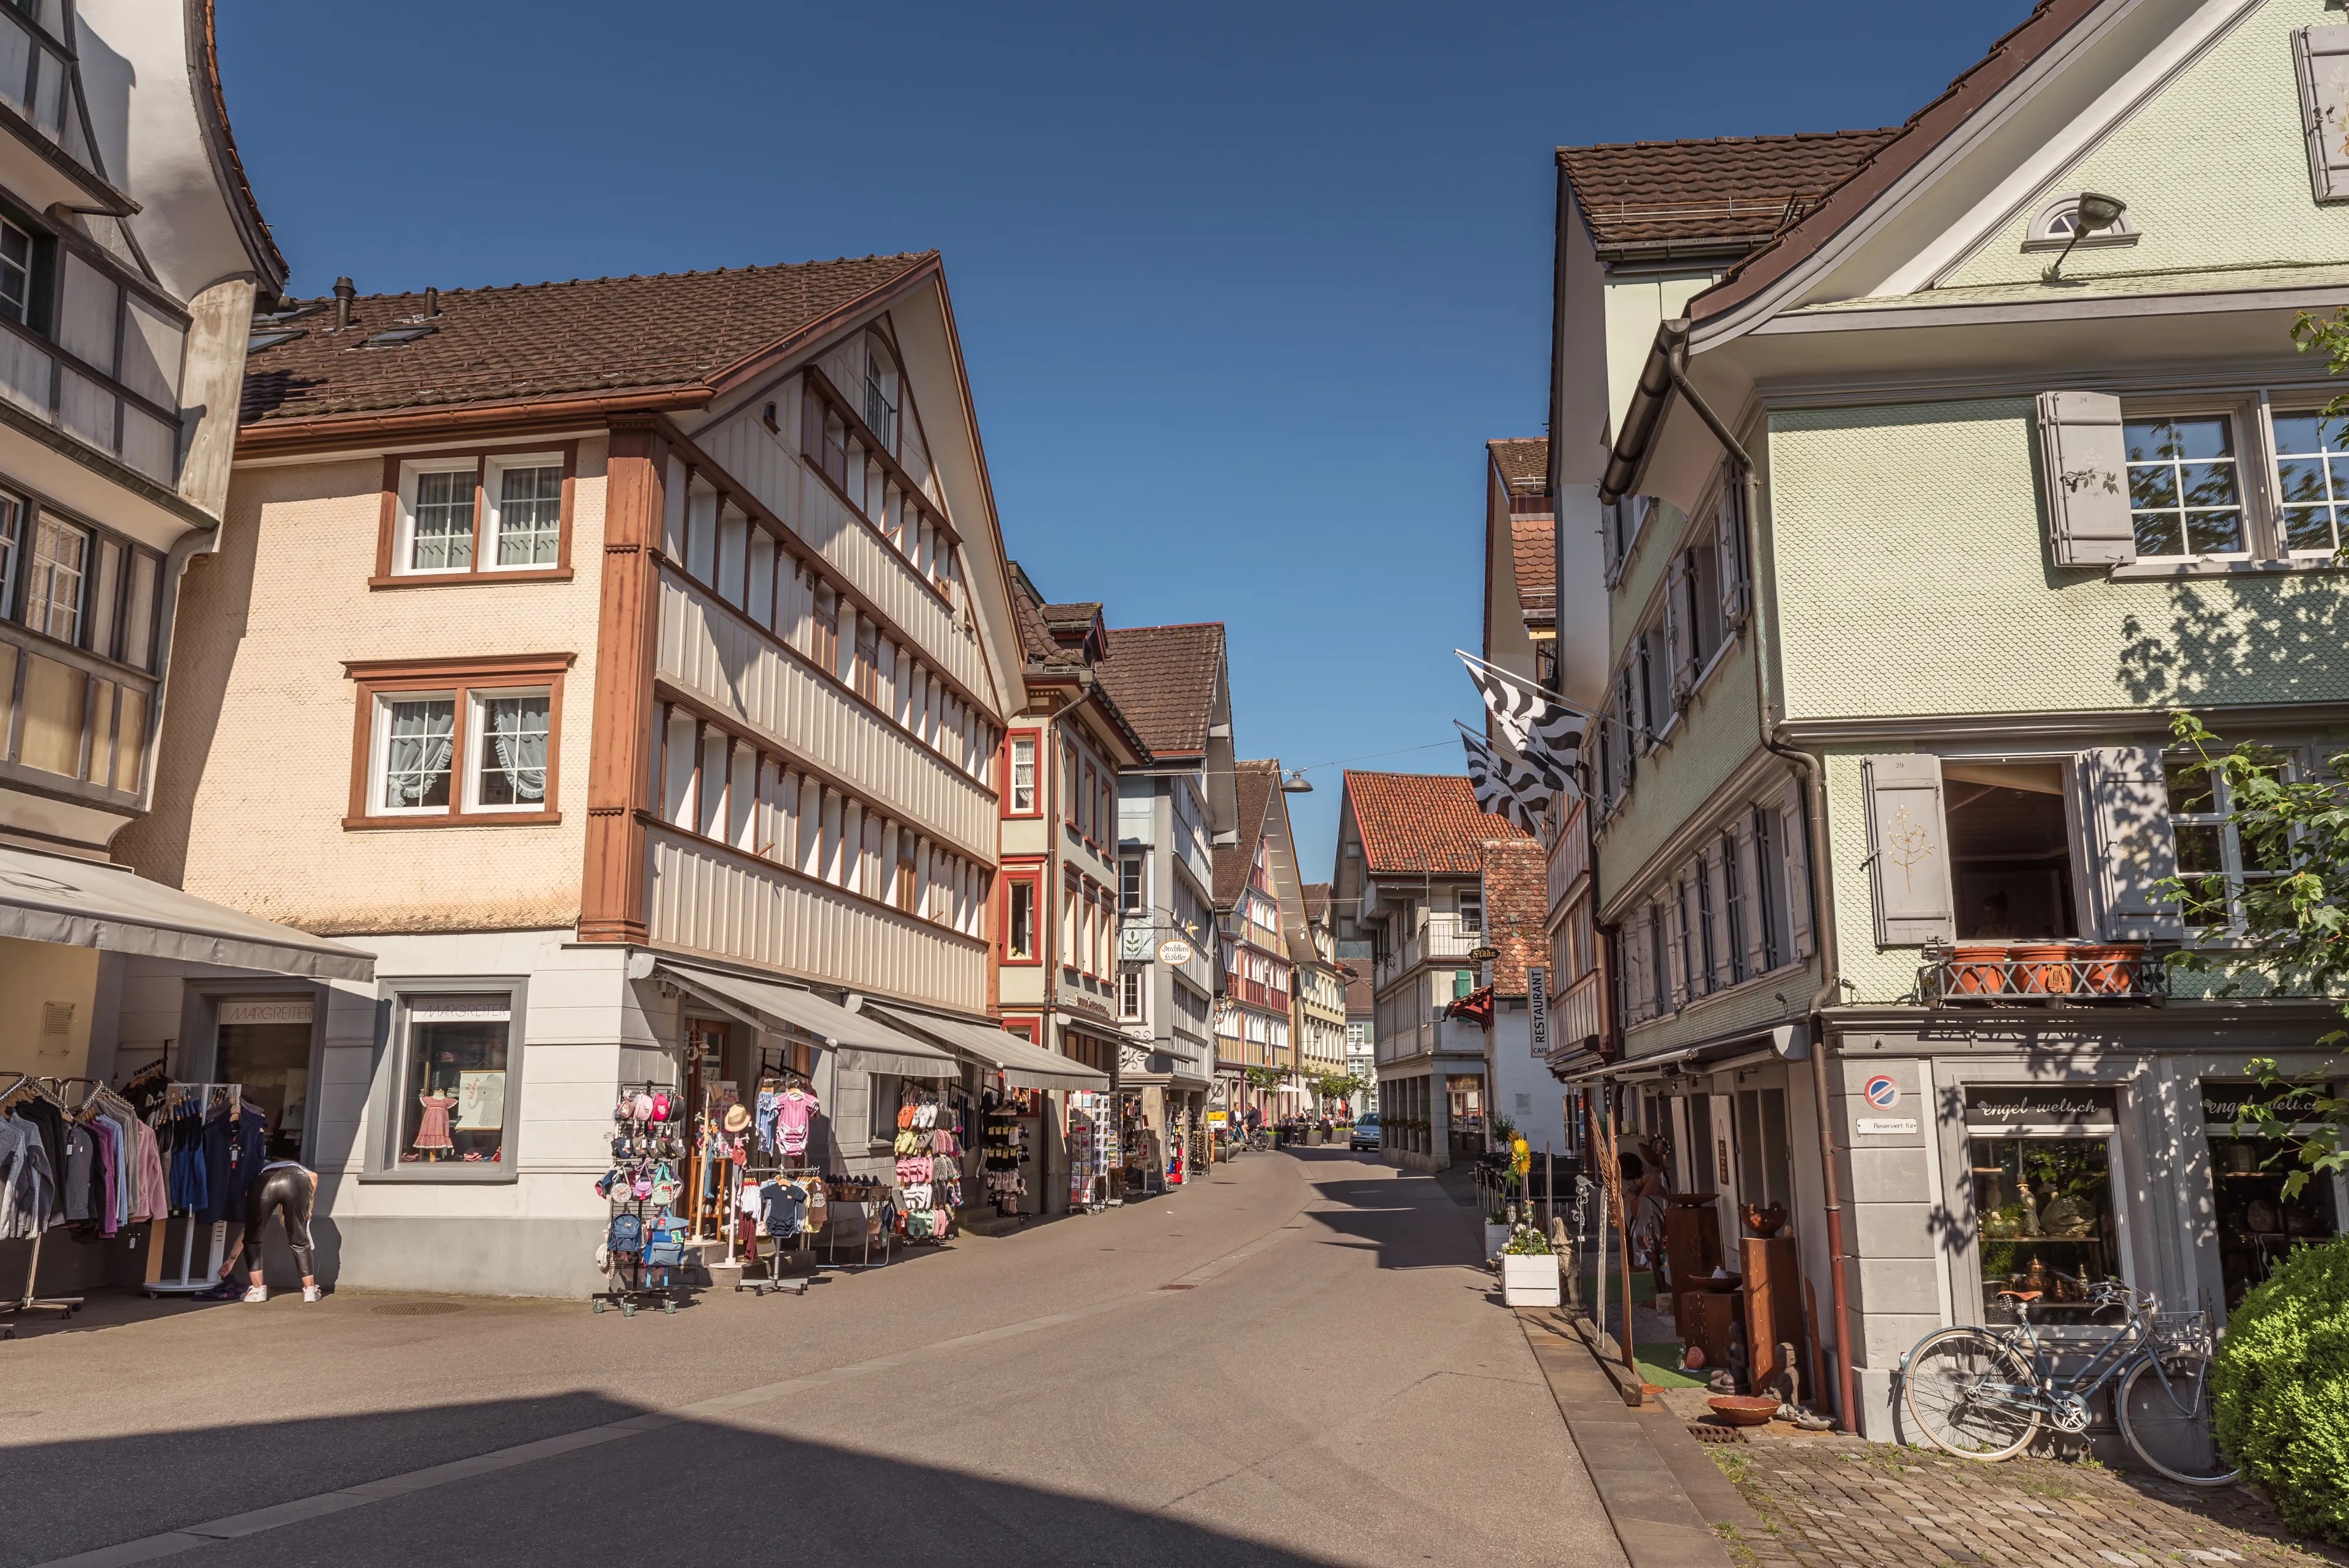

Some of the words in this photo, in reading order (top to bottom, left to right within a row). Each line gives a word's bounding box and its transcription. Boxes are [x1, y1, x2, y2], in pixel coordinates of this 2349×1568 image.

[1472, 949, 1496, 959] Flade
[229, 1006, 313, 1020] MARGREITER
[423, 1003, 508, 1017] MARGREITER
[1531, 970, 1545, 1043] RESTAURANT
[465, 1082, 472, 1091] BE
[467, 1077, 480, 1101] HAPPY
[1981, 1096, 2098, 1121] engel-welt.ch
